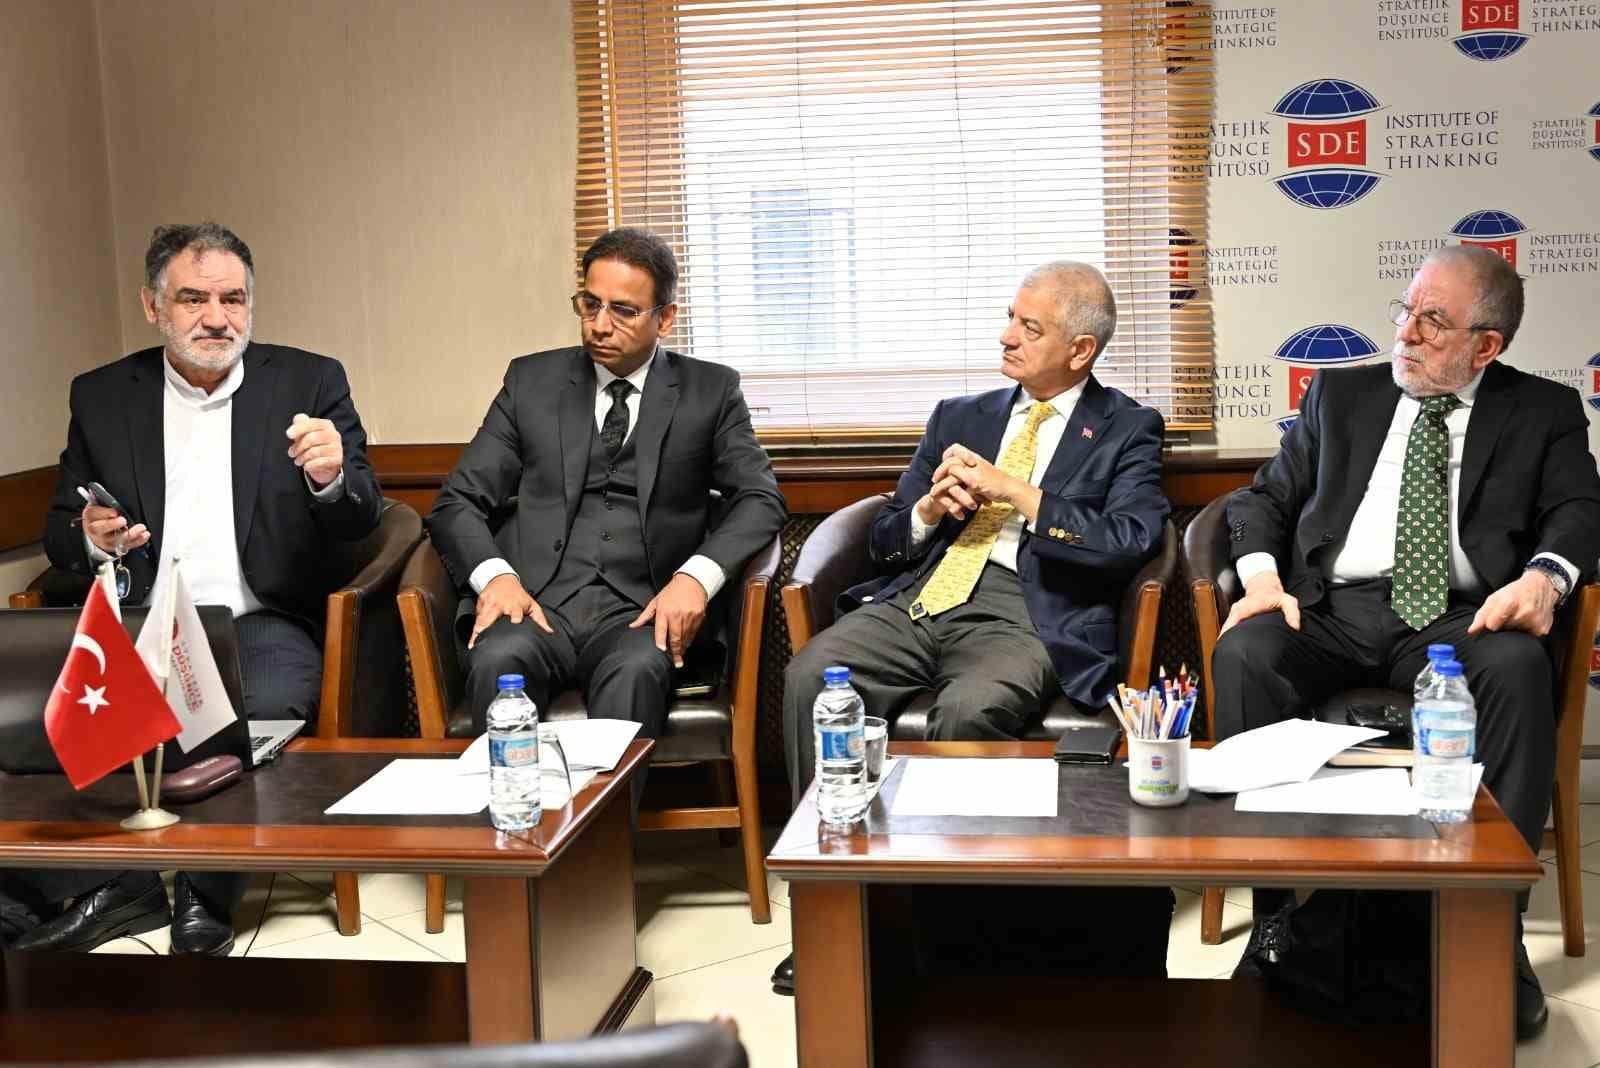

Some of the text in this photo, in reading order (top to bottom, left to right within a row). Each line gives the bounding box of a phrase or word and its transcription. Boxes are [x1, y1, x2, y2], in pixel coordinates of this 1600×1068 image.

[1199, 7, 1277, 20] STITUTE OF
[1468, 4, 1515, 24] SDE
[1532, 4, 1597, 18] STRATEG
[1378, 12, 1449, 27] DÜŞÜNCE
[1531, 19, 1600, 32] THINKIN
[1215, 21, 1277, 34] RATEGIC
[1385, 111, 1499, 129] INSTITUTE OF
[1296, 130, 1361, 158] SDE
[1385, 131, 1499, 149] STRATEGIC
[1384, 151, 1498, 169] THINKING
[1530, 233, 1592, 246] INSTITUTE
[1262, 245, 1278, 257] OF
[1530, 247, 1599, 259] STRATEGI
[1378, 252, 1427, 266] DÜŞÜN
[1378, 267, 1420, 280] ENSTİ
[1529, 261, 1598, 273] THINKIN
